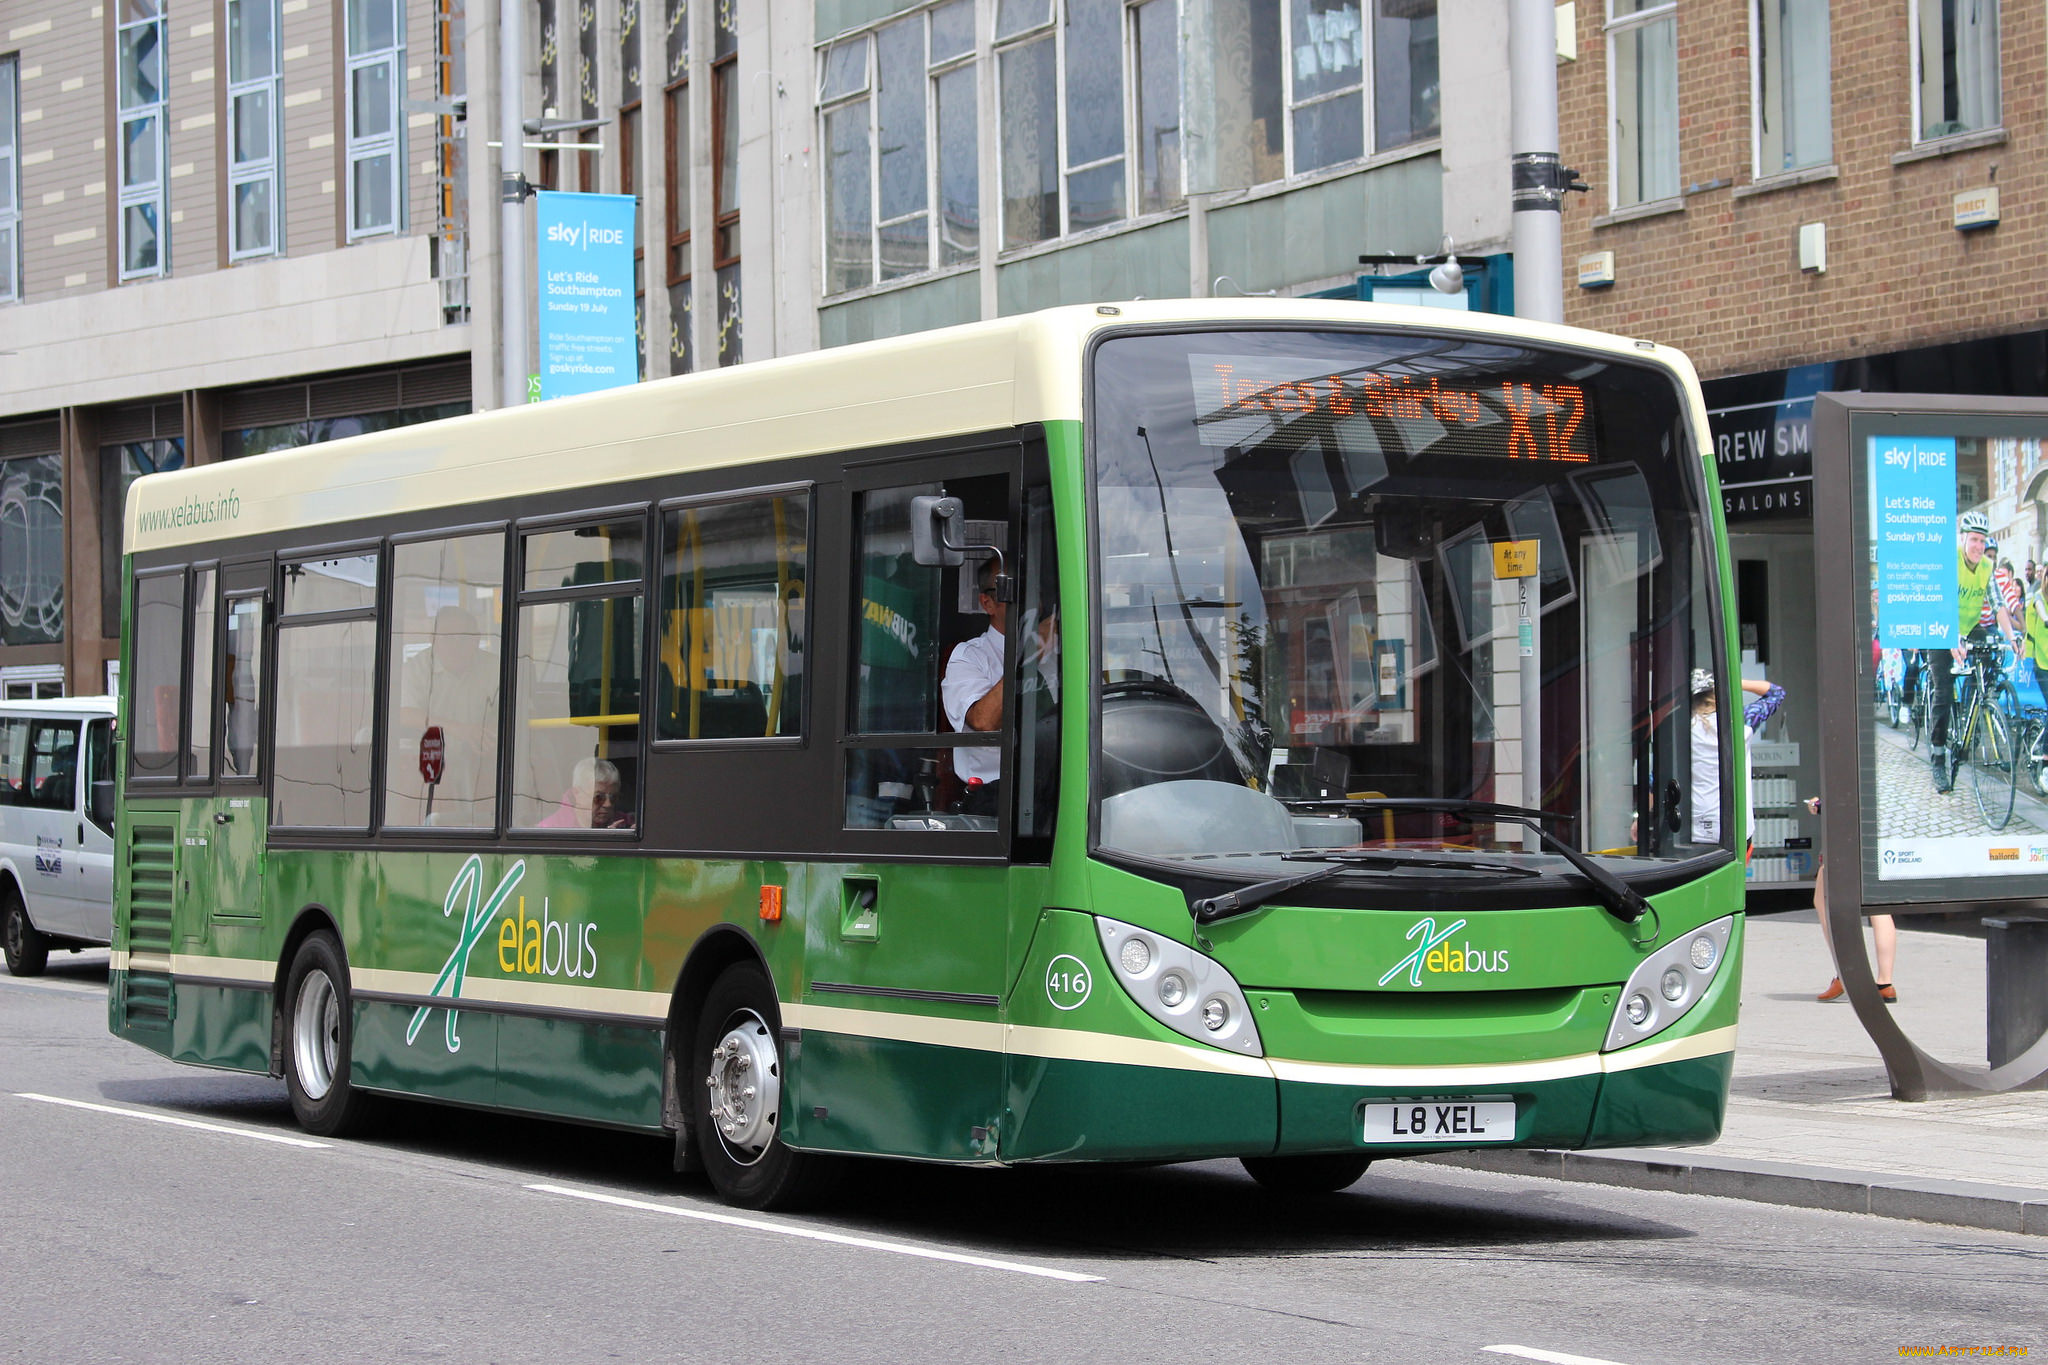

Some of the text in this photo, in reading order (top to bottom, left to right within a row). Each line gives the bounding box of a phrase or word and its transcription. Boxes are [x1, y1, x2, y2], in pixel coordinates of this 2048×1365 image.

[547, 222, 623, 246] sky RIDE
[547, 271, 599, 284] Let's Ride
[547, 283, 622, 299] Southampton
[547, 302, 608, 314] Sunday 19 July
[549, 363, 616, 375] goskyride.com
[1214, 364, 1479, 422] Tesco & Shirley
[1502, 382, 1589, 462] X12
[1718, 424, 1809, 464] REW SM
[1884, 447, 1947, 469] sky RIDE
[139, 488, 240, 533] www.xelabus.info
[1725, 491, 1801, 512] SALONS
[1885, 496, 1935, 509] Let's Ride
[1885, 513, 1947, 525] Southampton
[1886, 531, 1943, 544] Sunday 19 July
[1514, 550, 1527, 560] any
[1507, 563, 1522, 572] time
[1887, 593, 1943, 603] goskyride.com
[1928, 621, 1950, 639] sky
[1378, 917, 1510, 987] Xelabus
[1049, 972, 1087, 994] 416
[1392, 1105, 1486, 1135] L8 XEL
